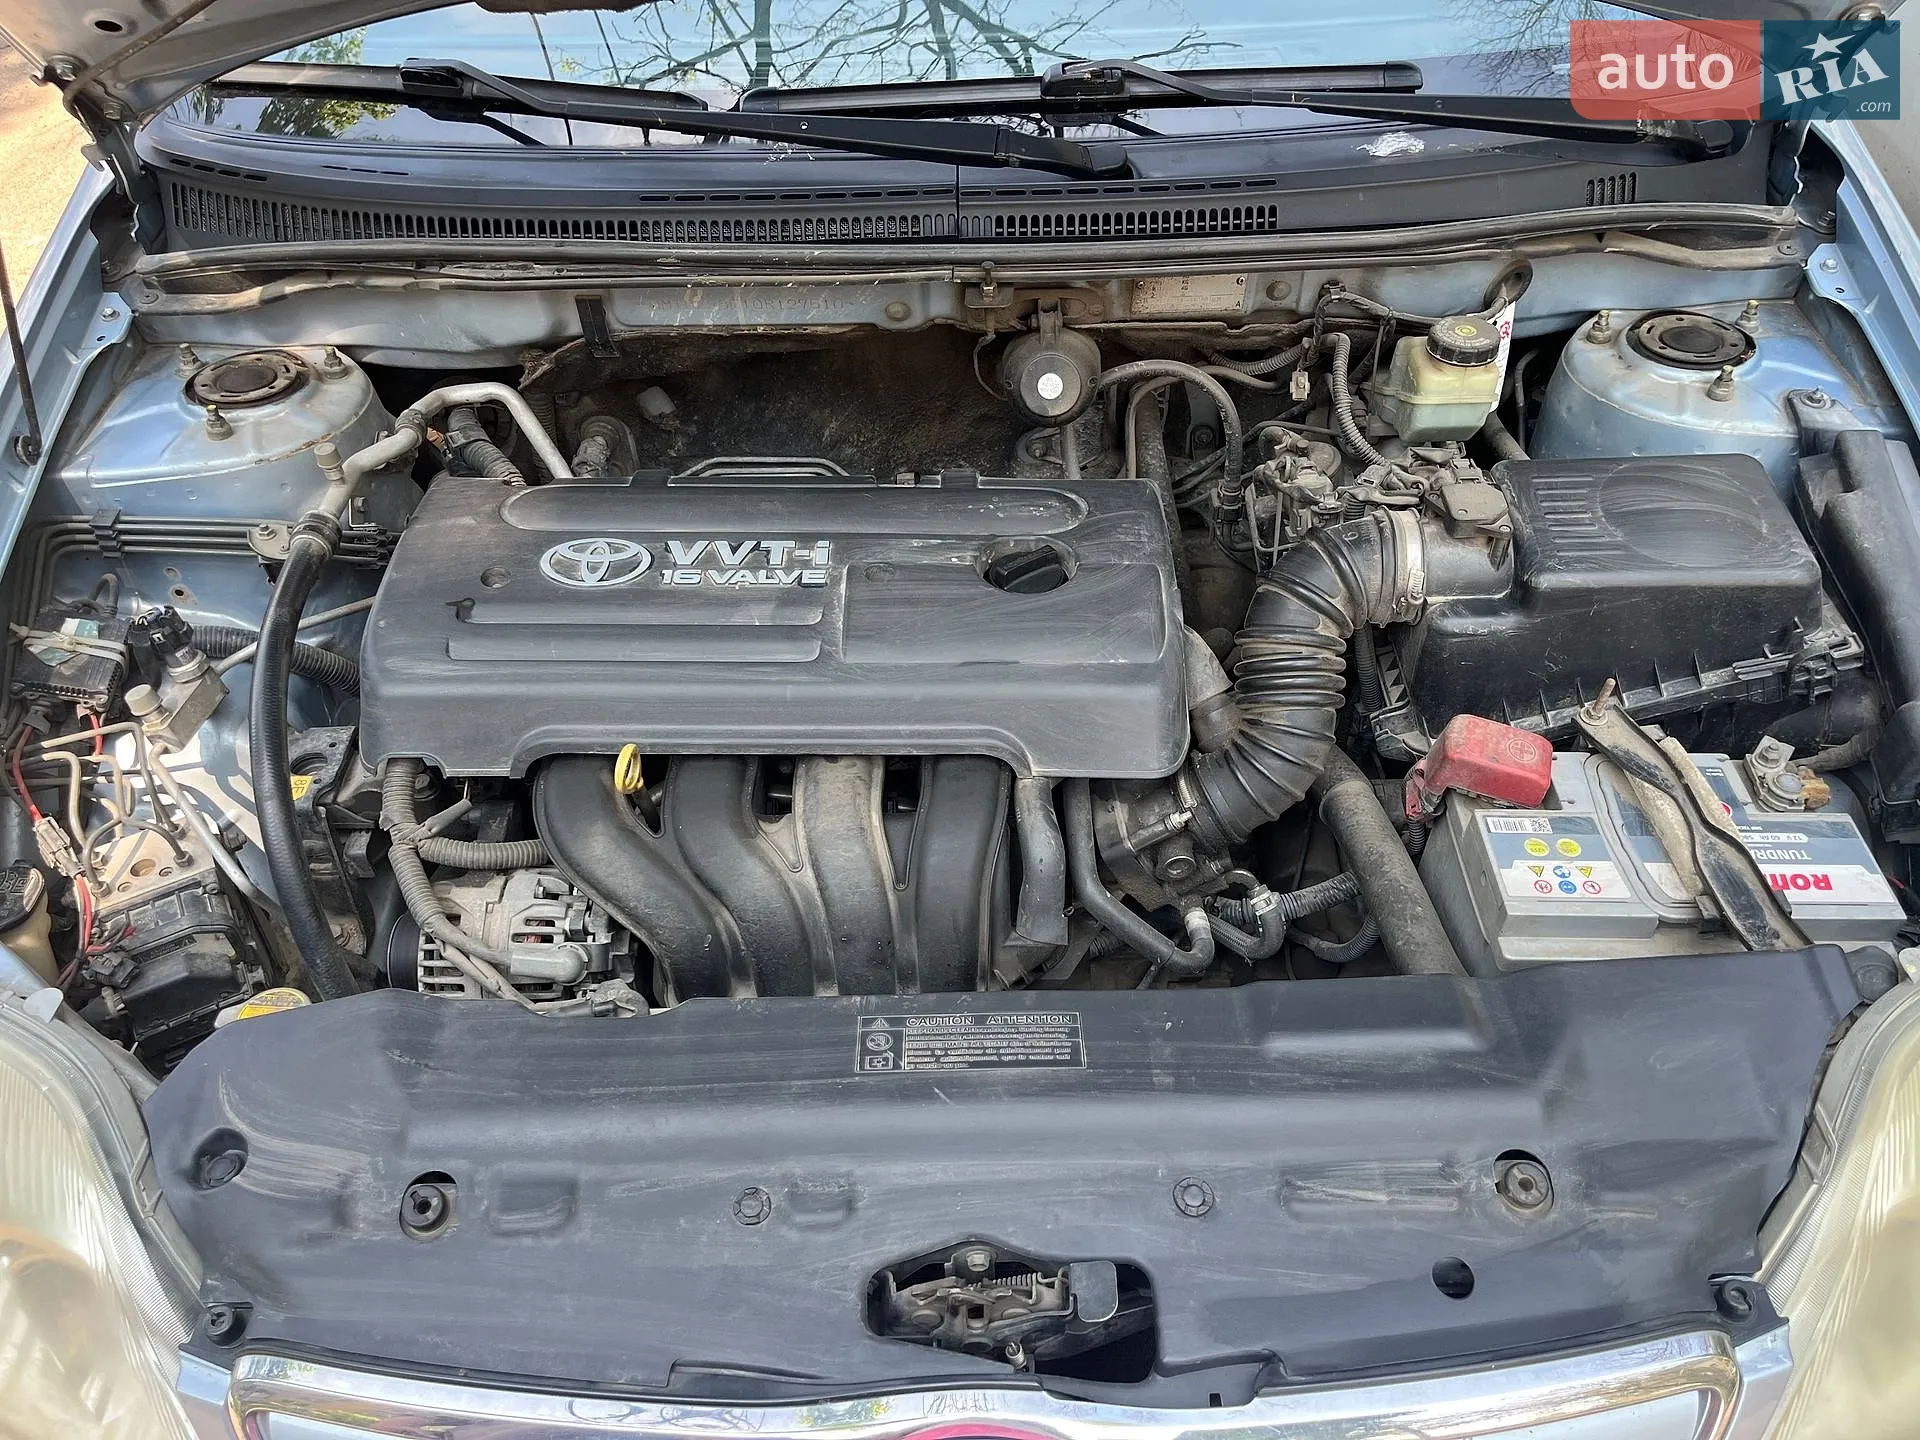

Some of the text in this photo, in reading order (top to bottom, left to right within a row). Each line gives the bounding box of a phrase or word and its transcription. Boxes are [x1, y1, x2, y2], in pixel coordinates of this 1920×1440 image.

[666, 540, 831, 566] VVT-i
[661, 569, 829, 585] 16 VALVE
[907, 1015, 1073, 1027] CAUTION ATTENTION
